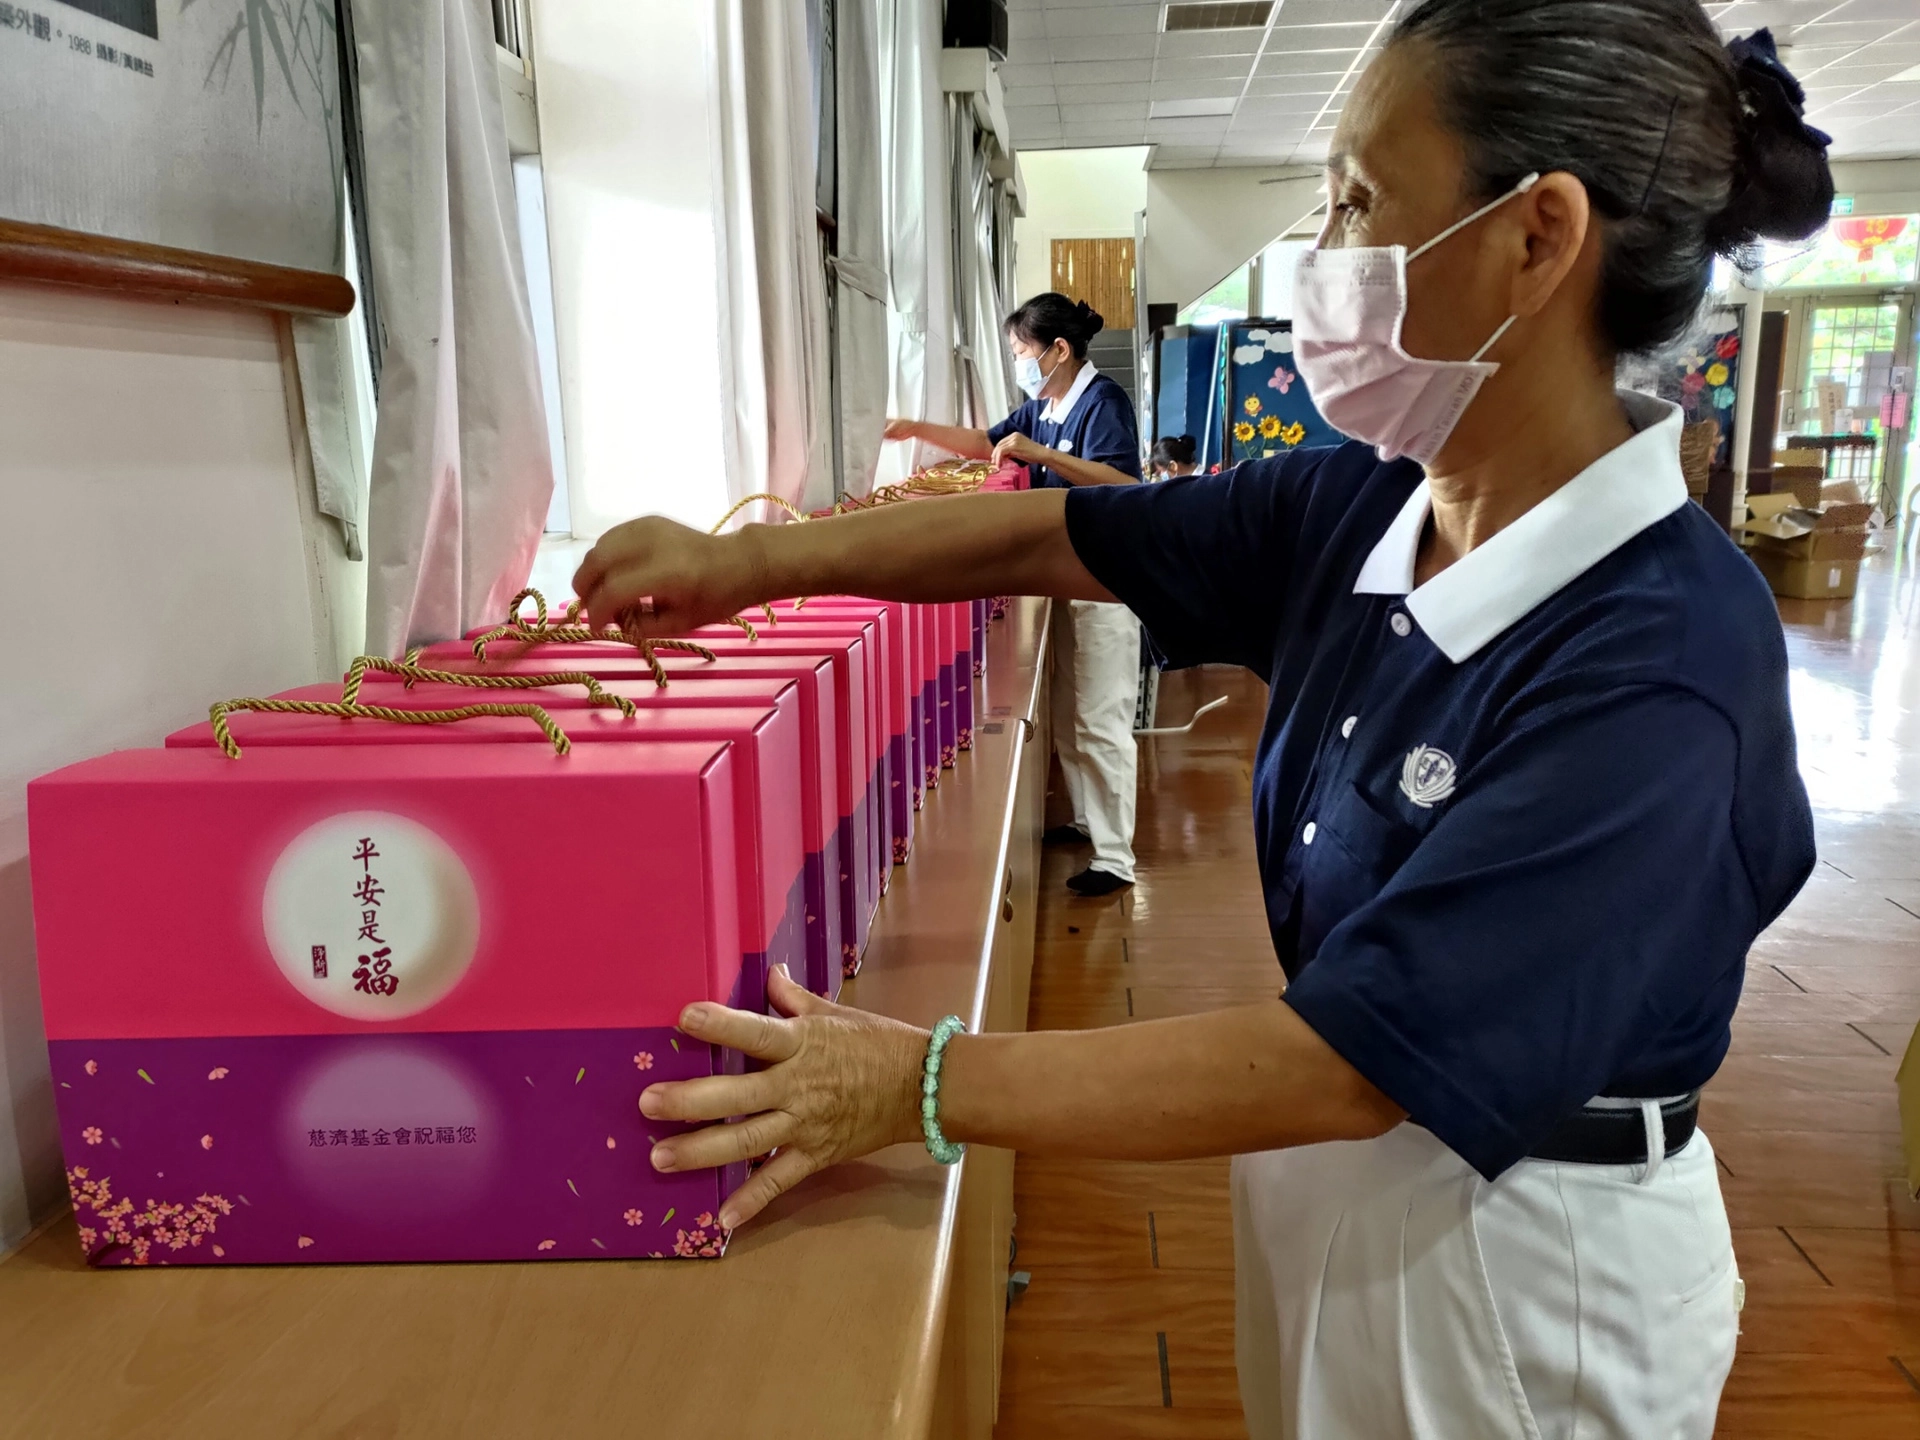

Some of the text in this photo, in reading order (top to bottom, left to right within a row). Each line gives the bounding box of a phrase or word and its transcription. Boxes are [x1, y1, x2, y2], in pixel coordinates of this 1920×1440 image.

[352, 837, 399, 996] 平安是福
[308, 1126, 477, 1147] 慈濟基金會祝福您
